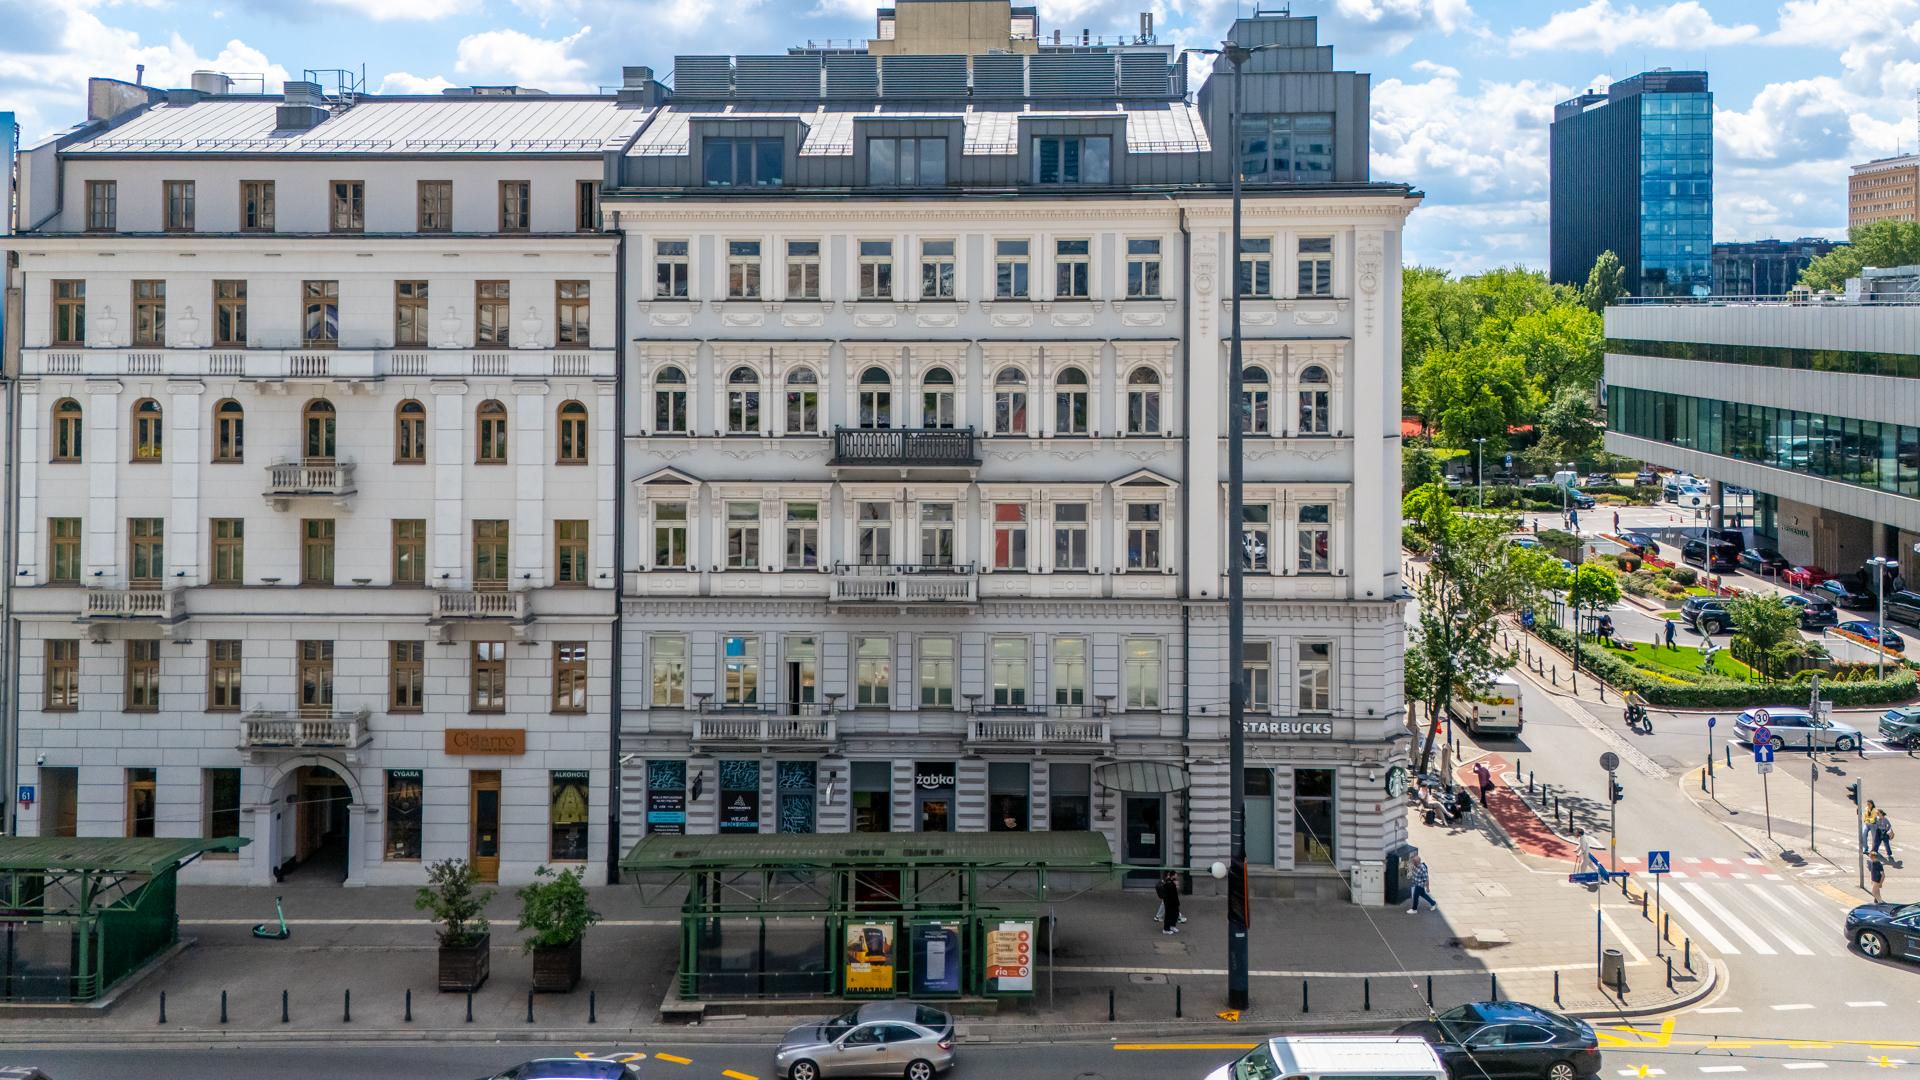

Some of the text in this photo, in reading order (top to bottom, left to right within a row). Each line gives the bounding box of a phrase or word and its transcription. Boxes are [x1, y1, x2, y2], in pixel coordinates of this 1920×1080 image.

[1757, 714, 1767, 722] 30
[1242, 722, 1332, 734] STARBUCKS
[453, 732, 516, 750] Cigarro
[916, 773, 954, 786] żabka
[22, 792, 30, 800] 61
[995, 967, 1008, 976] ria
